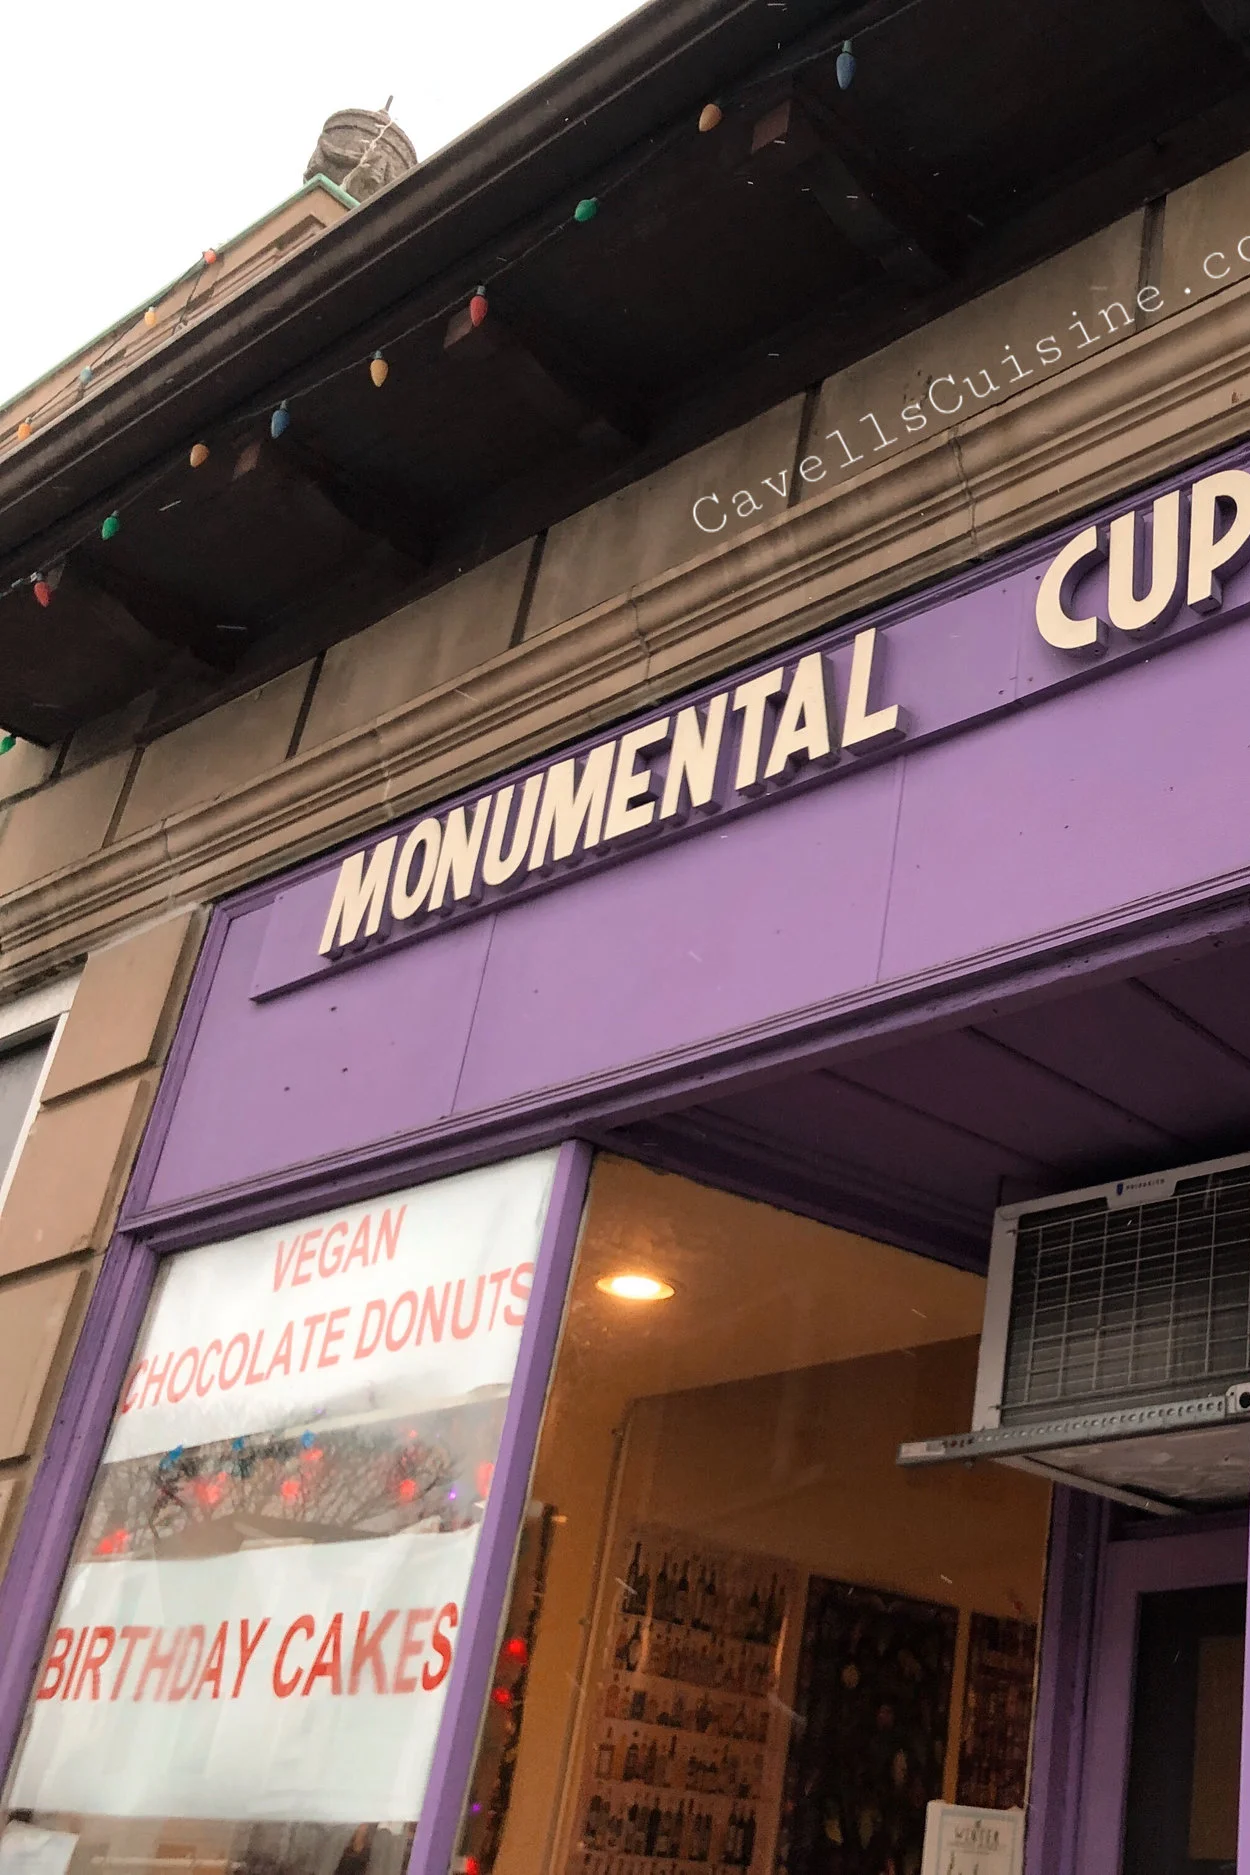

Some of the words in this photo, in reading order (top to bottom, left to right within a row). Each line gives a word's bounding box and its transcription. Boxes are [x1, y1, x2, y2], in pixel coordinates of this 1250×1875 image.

[318, 627, 901, 957] MONUMENTAL
[272, 1205, 407, 1292] VEGAN
[354, 1262, 535, 1360] DONUTS
[36, 1616, 271, 1703] BIRTHDAY
[271, 1601, 458, 1700] CAKES
